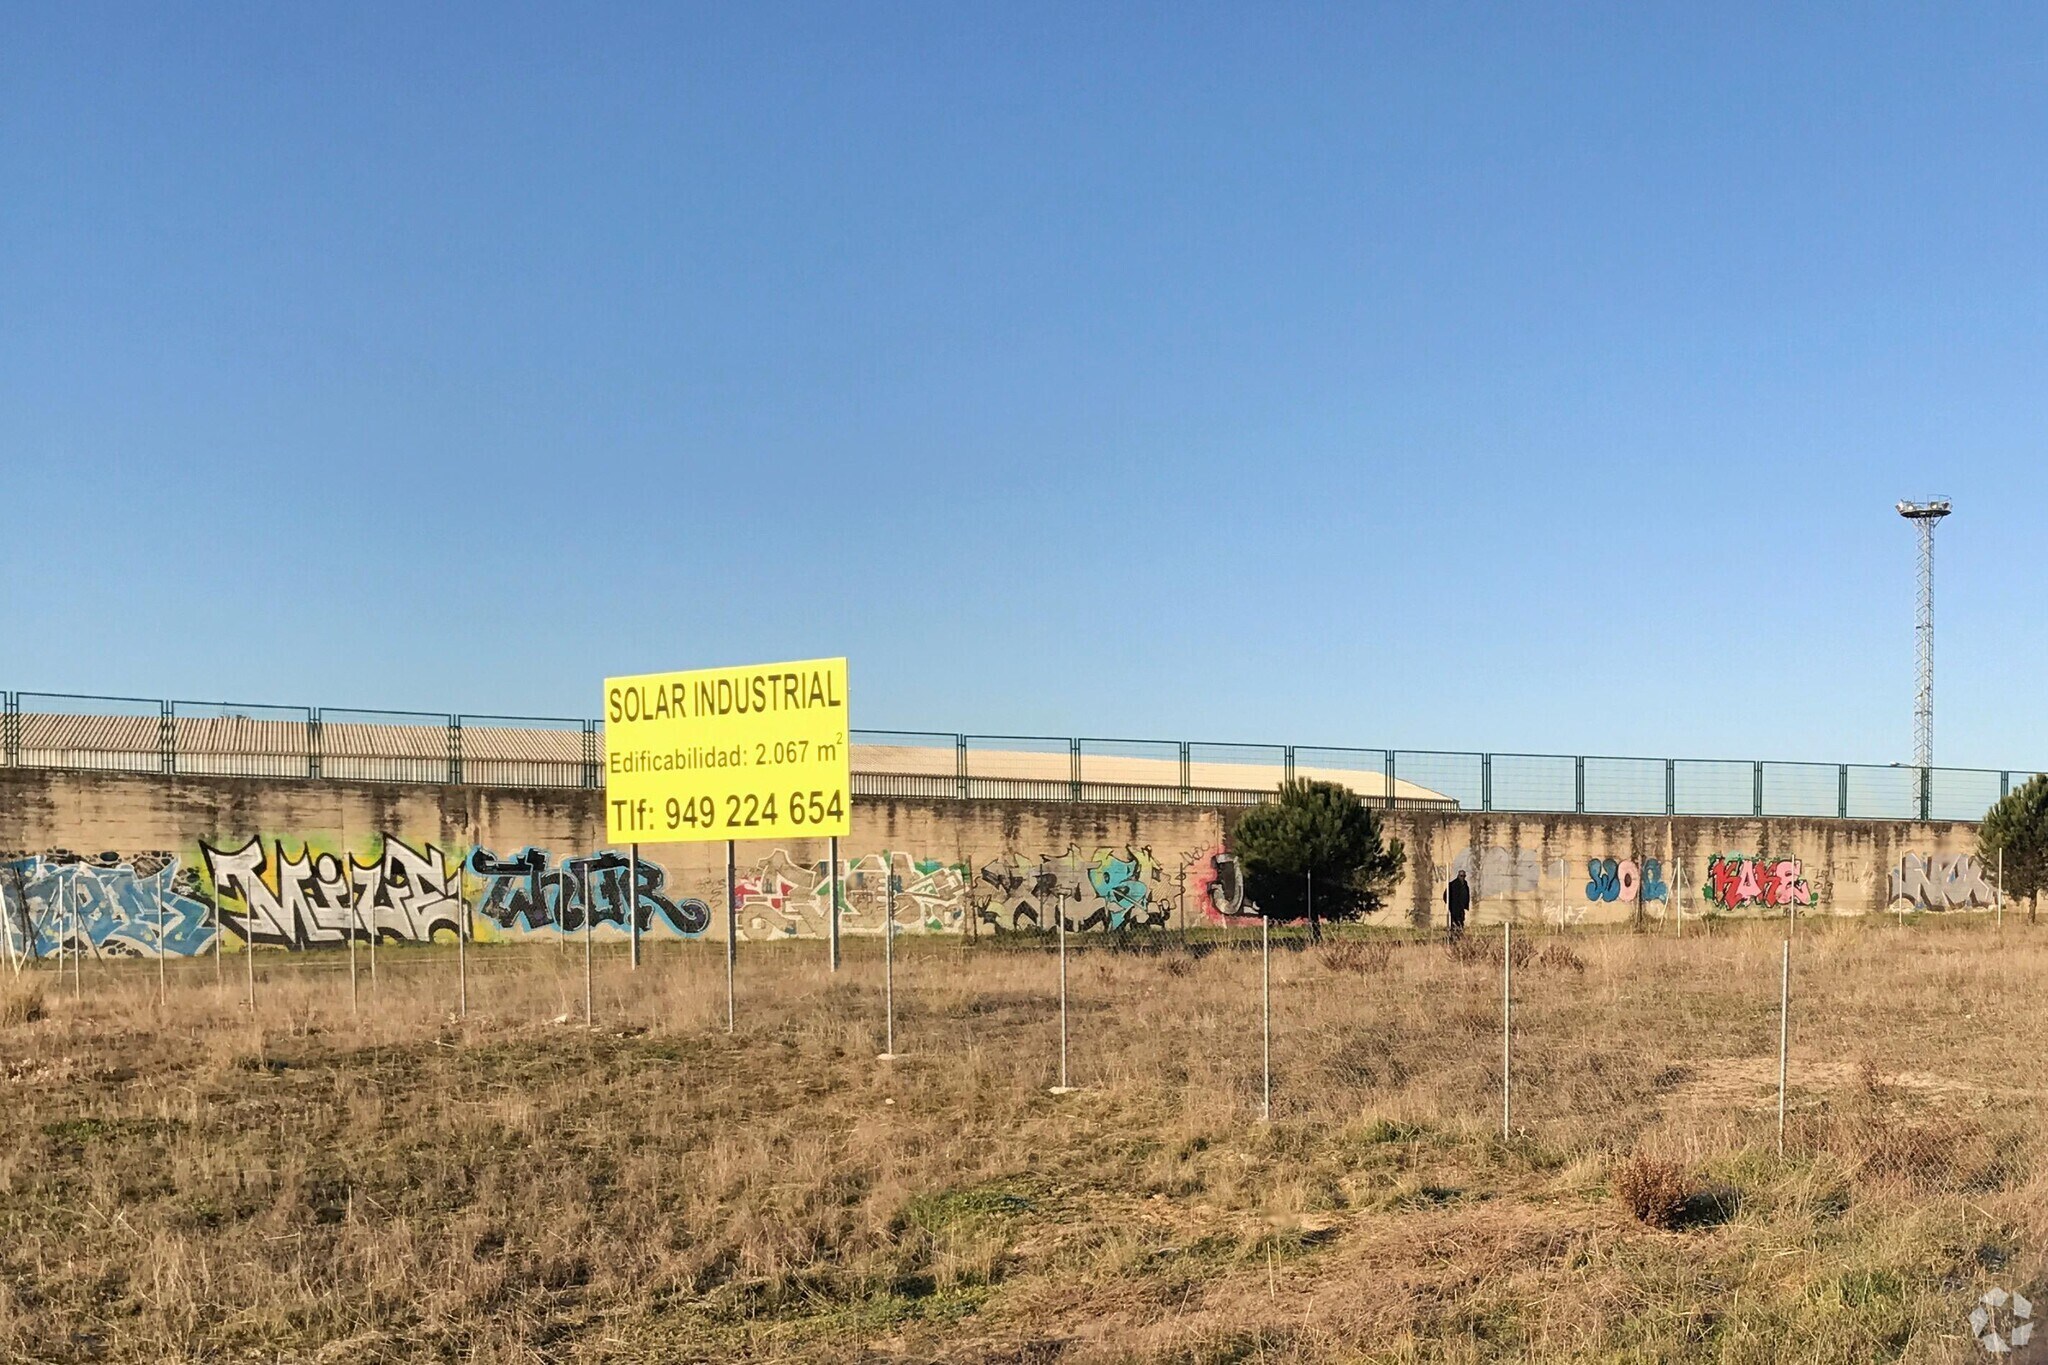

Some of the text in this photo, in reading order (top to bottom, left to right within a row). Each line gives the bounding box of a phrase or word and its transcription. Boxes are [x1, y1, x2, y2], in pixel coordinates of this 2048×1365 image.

[610, 670, 841, 724] SOLAR INDUSTRIAL
[610, 744, 747, 773] Edificabilidad:
[756, 740, 809, 766] 2.067
[611, 789, 844, 831] Tlf: 949 224 654
